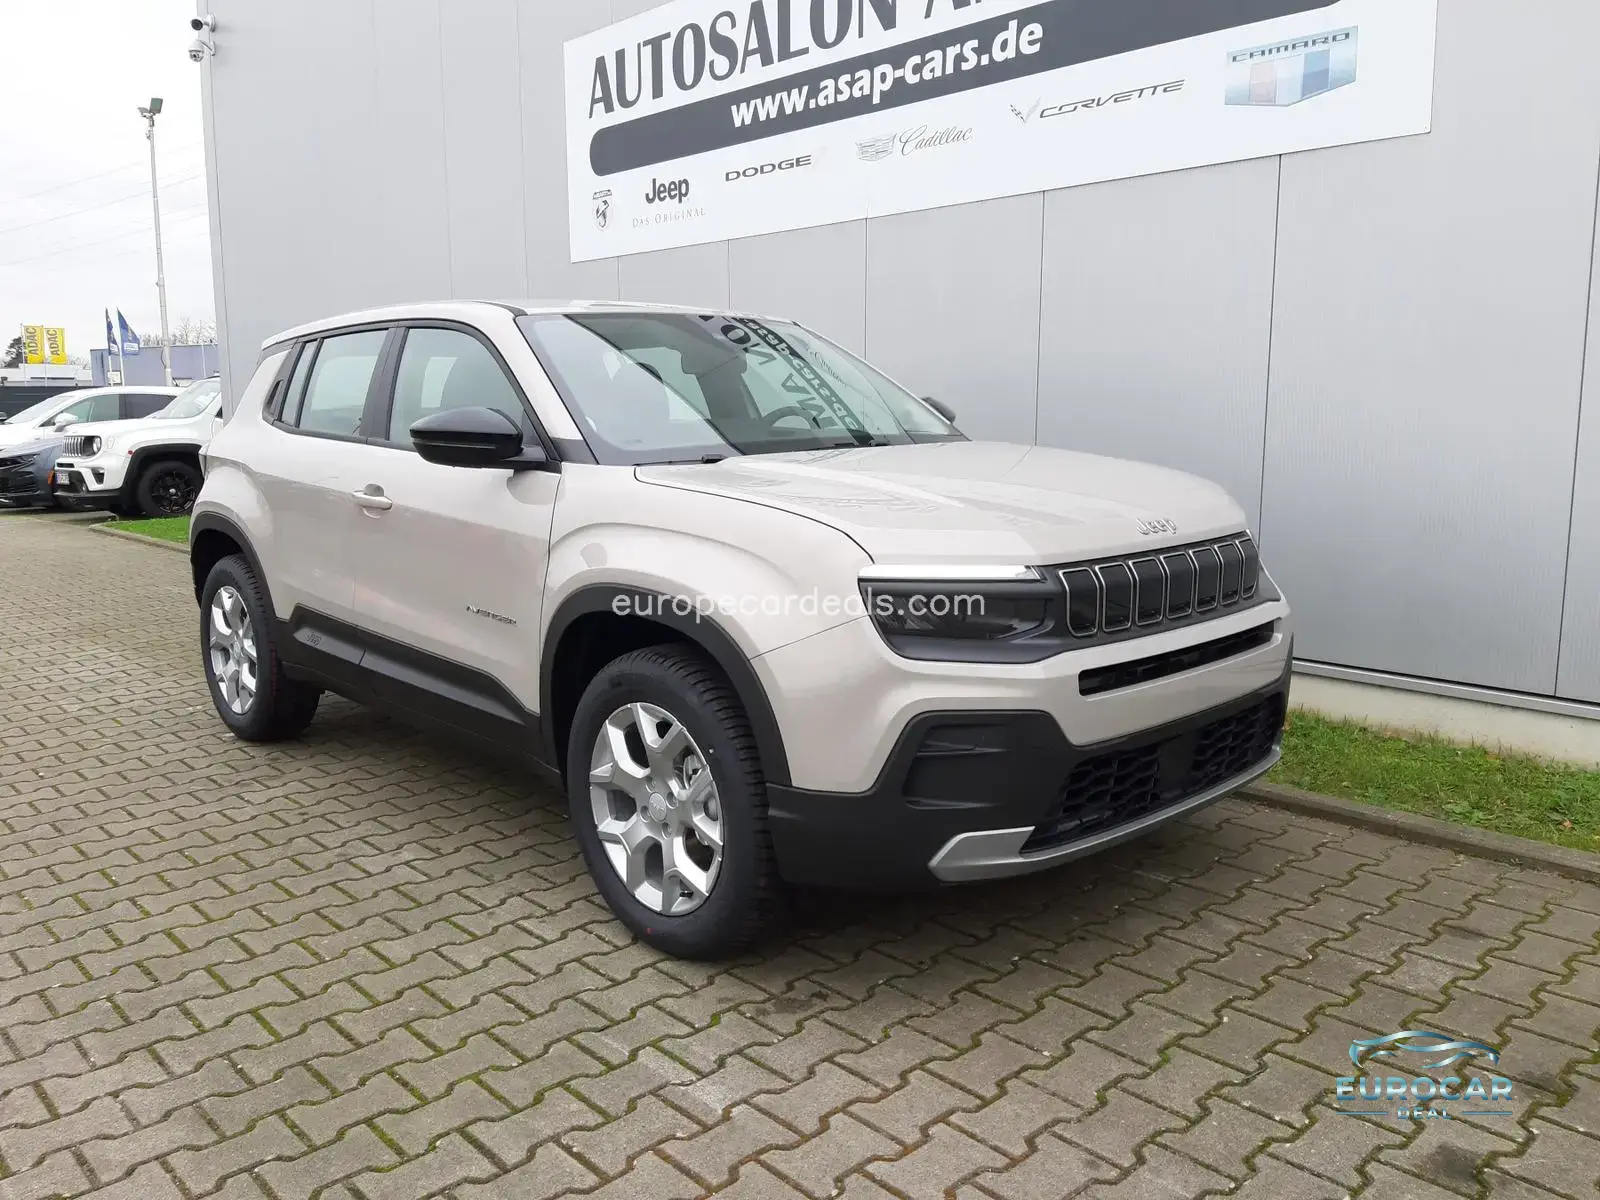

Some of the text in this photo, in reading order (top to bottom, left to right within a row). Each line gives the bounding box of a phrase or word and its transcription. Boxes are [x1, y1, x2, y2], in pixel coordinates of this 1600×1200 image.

[1232, 31, 1351, 63] CAMARO
[730, 19, 1044, 128] www.asap-cars.de
[1039, 79, 1186, 119] CORVETTE
[898, 124, 973, 156] Cadillac
[724, 154, 812, 182] DODGE
[644, 178, 690, 205] Jeep
[25, 327, 39, 356] ADAC
[46, 329, 60, 356] ADAC
[1135, 517, 1177, 537] Jeep
